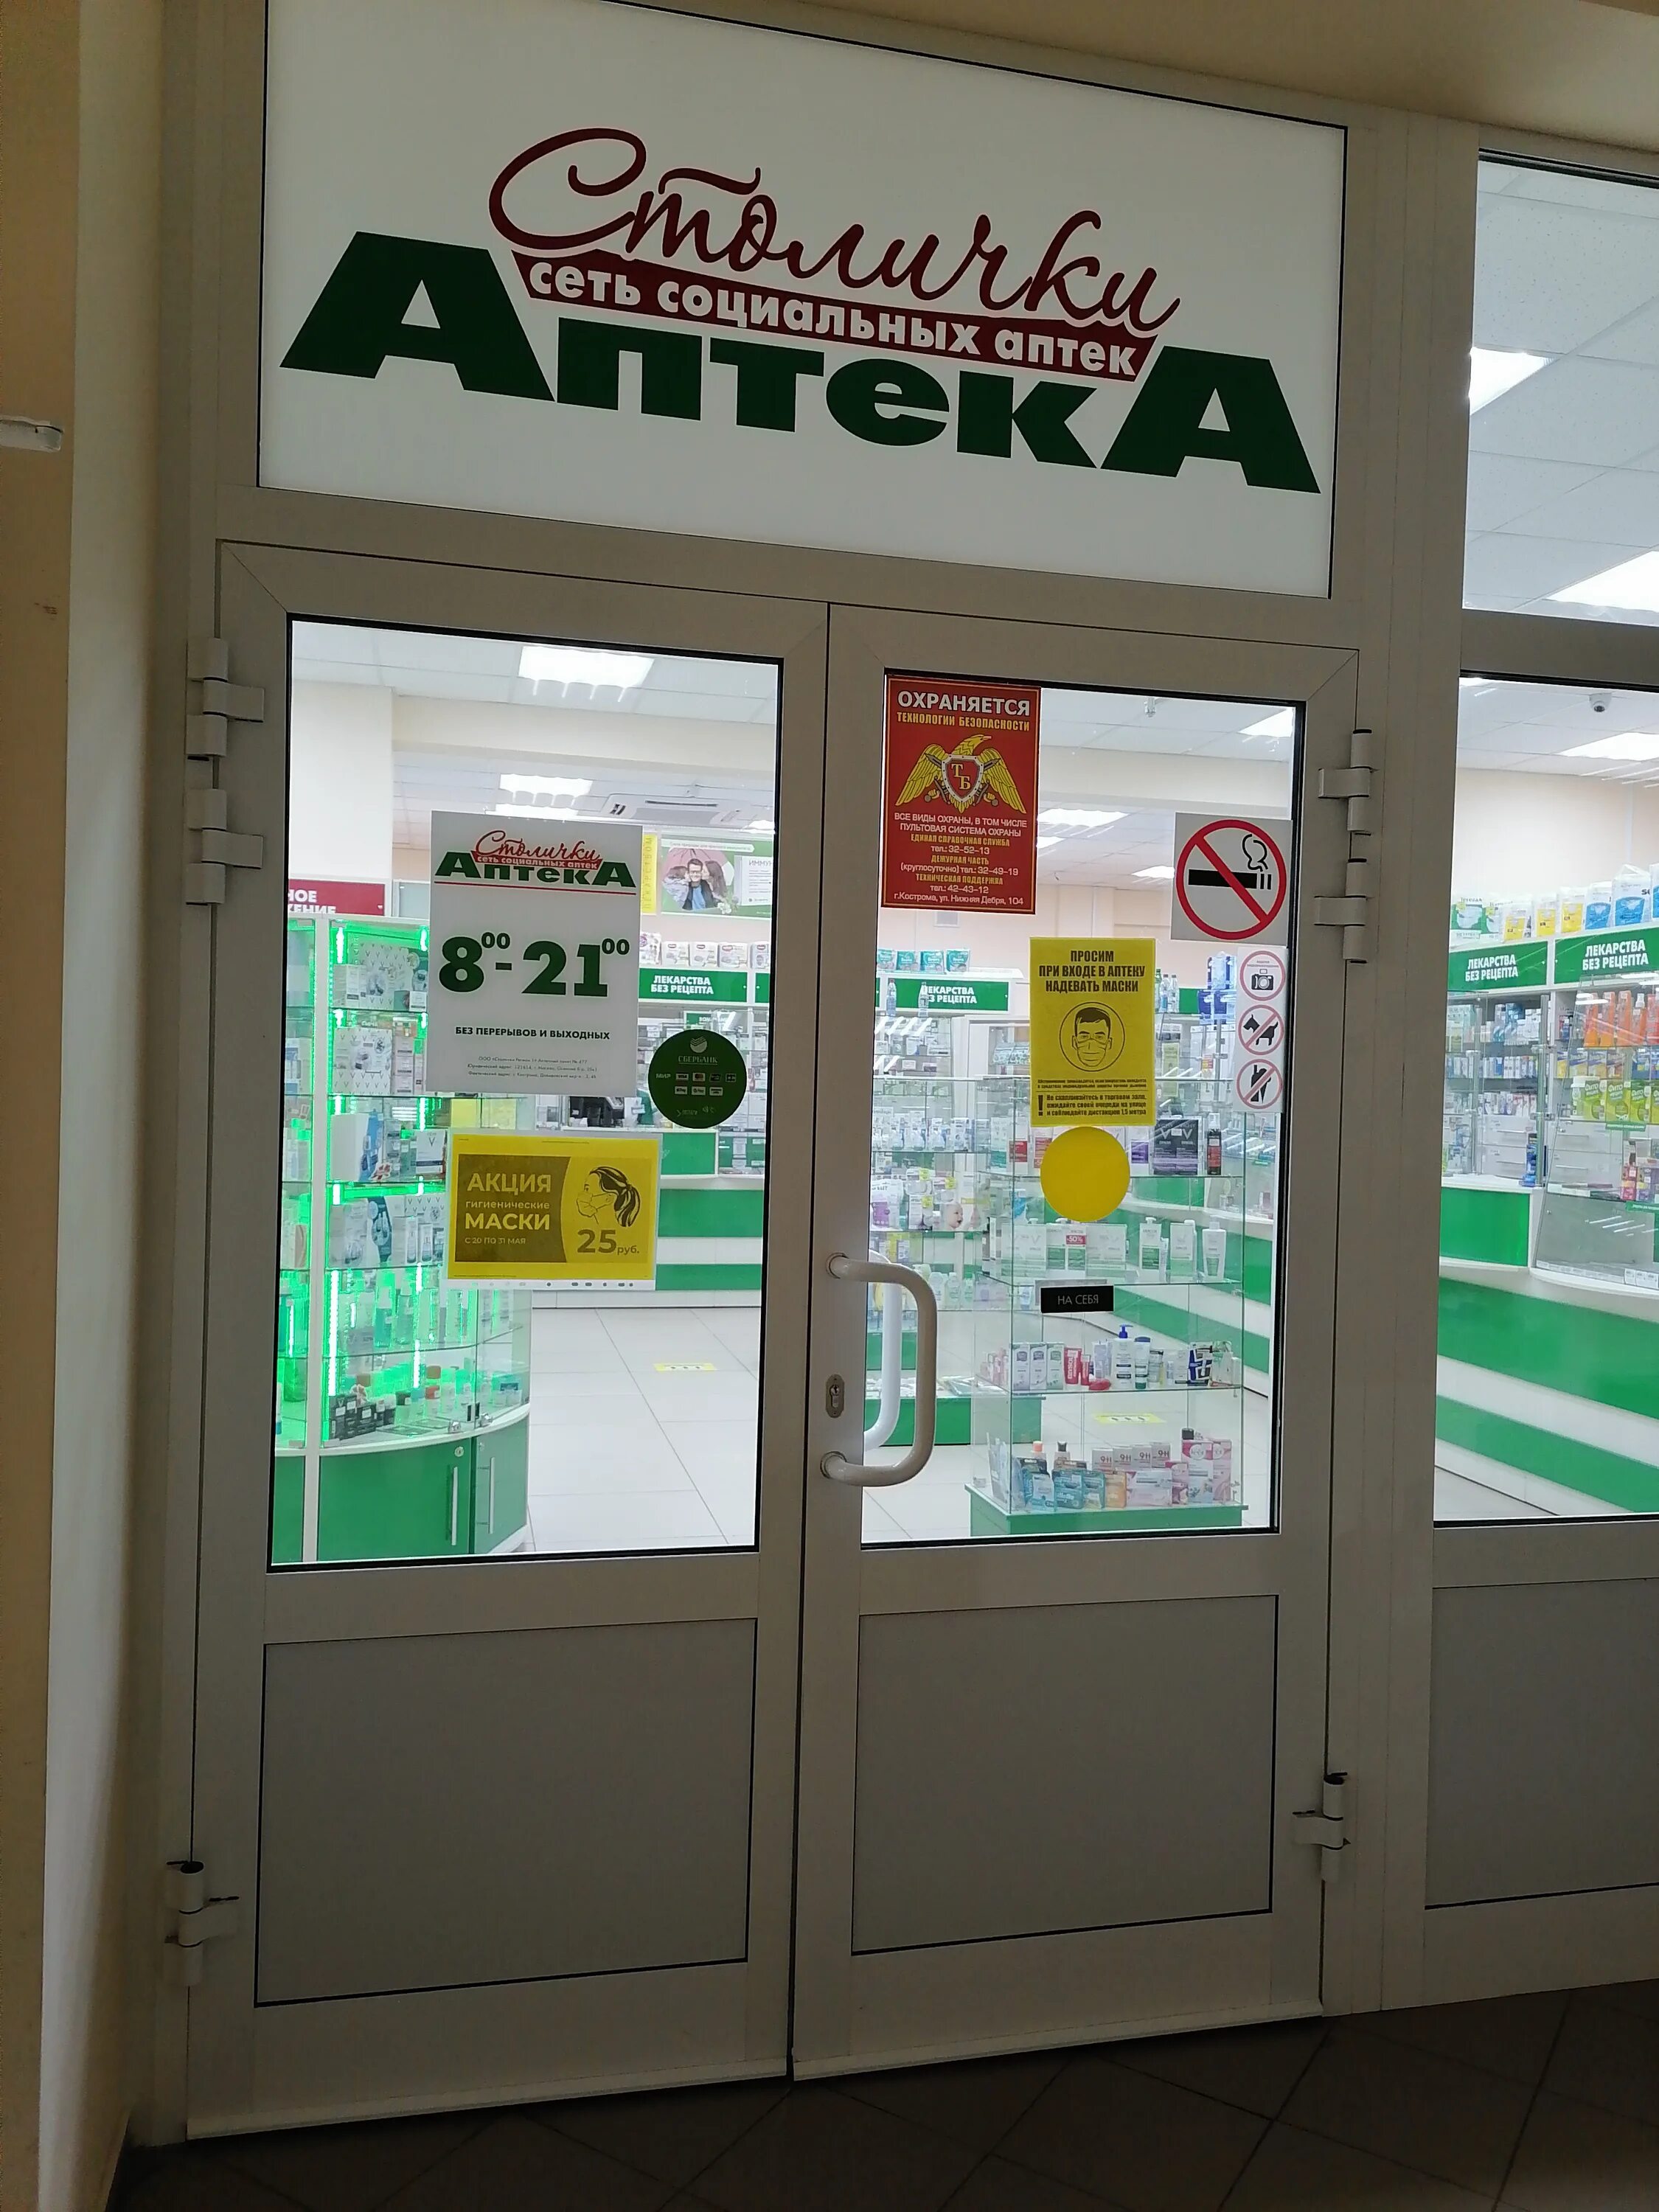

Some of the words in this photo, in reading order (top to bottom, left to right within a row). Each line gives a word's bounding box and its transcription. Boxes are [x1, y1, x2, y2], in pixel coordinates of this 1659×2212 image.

[489, 128, 1180, 336] Столички
[529, 257, 641, 308] сеть
[656, 275, 981, 356] социальных
[993, 325, 1137, 377] аптек
[897, 690, 1031, 717] ОХРАНЯЕТСЯ
[897, 712, 956, 726] ТЕХНОЛОГИИ
[959, 716, 1031, 731] БЕЗОПАСНОСТИ
[894, 812, 911, 821] ВСЕ
[912, 813, 936, 823] ВИДЫ
[937, 815, 973, 826] ОХРАНЫ,
[982, 818, 1000, 827] ТОМ
[1001, 818, 1027, 828] ЧИСЛЕ
[900, 822, 947, 833] ПУЛЬТОВАЯ
[947, 825, 987, 835] СИСТЕМА
[988, 828, 1021, 837] ОХРАНЫ
[476, 830, 602, 860] Столички
[477, 855, 499, 864] сеть
[1008, 897, 1024, 905] 104
[1070, 950, 1115, 962] ПРОСИМ
[1585, 939, 1646, 958] ЛЕКАРСТВА
[1467, 954, 1517, 970] ЛЕКАРСТВА
[1582, 958, 1600, 971] БЕЗ
[1601, 953, 1649, 970] РЕЦЕПТА
[1039, 965, 1060, 977] ПРИ
[1062, 965, 1096, 979] ВХОДЕ
[1098, 966, 1106, 977] В
[1107, 965, 1146, 978] АПТЕКУ
[1465, 970, 1479, 982] БЕЗ
[1481, 967, 1519, 981] РЕЦЕПТА
[653, 975, 712, 986] ЛЕКАРСТВА
[1045, 980, 1100, 994] НАДЕВАТЬ
[1102, 980, 1139, 992] МАСКИ
[650, 984, 669, 993] БЕЗ
[670, 984, 714, 995] РЕЦЕПТА
[936, 995, 978, 1004] РЕЦЕПТА
[455, 1026, 473, 1037] БЕЗ
[476, 1027, 538, 1038] ПЕРЕРЫВОВ
[539, 1029, 547, 1038] И
[549, 1030, 611, 1040] ВЫХОДНЫХ
[678, 1055, 718, 1063] СБЕРБАНК
[467, 1172, 552, 1196] АКЦИЯ
[465, 1200, 551, 1210] гигиенические
[465, 1212, 551, 1231] МАСКИ
[507, 1237, 526, 1245] МАЯ
[576, 1228, 617, 1254] 25
[617, 1244, 640, 1256] руб.
[1057, 1295, 1073, 1305] НА
[1075, 1294, 1099, 1304] СЕБЯ
